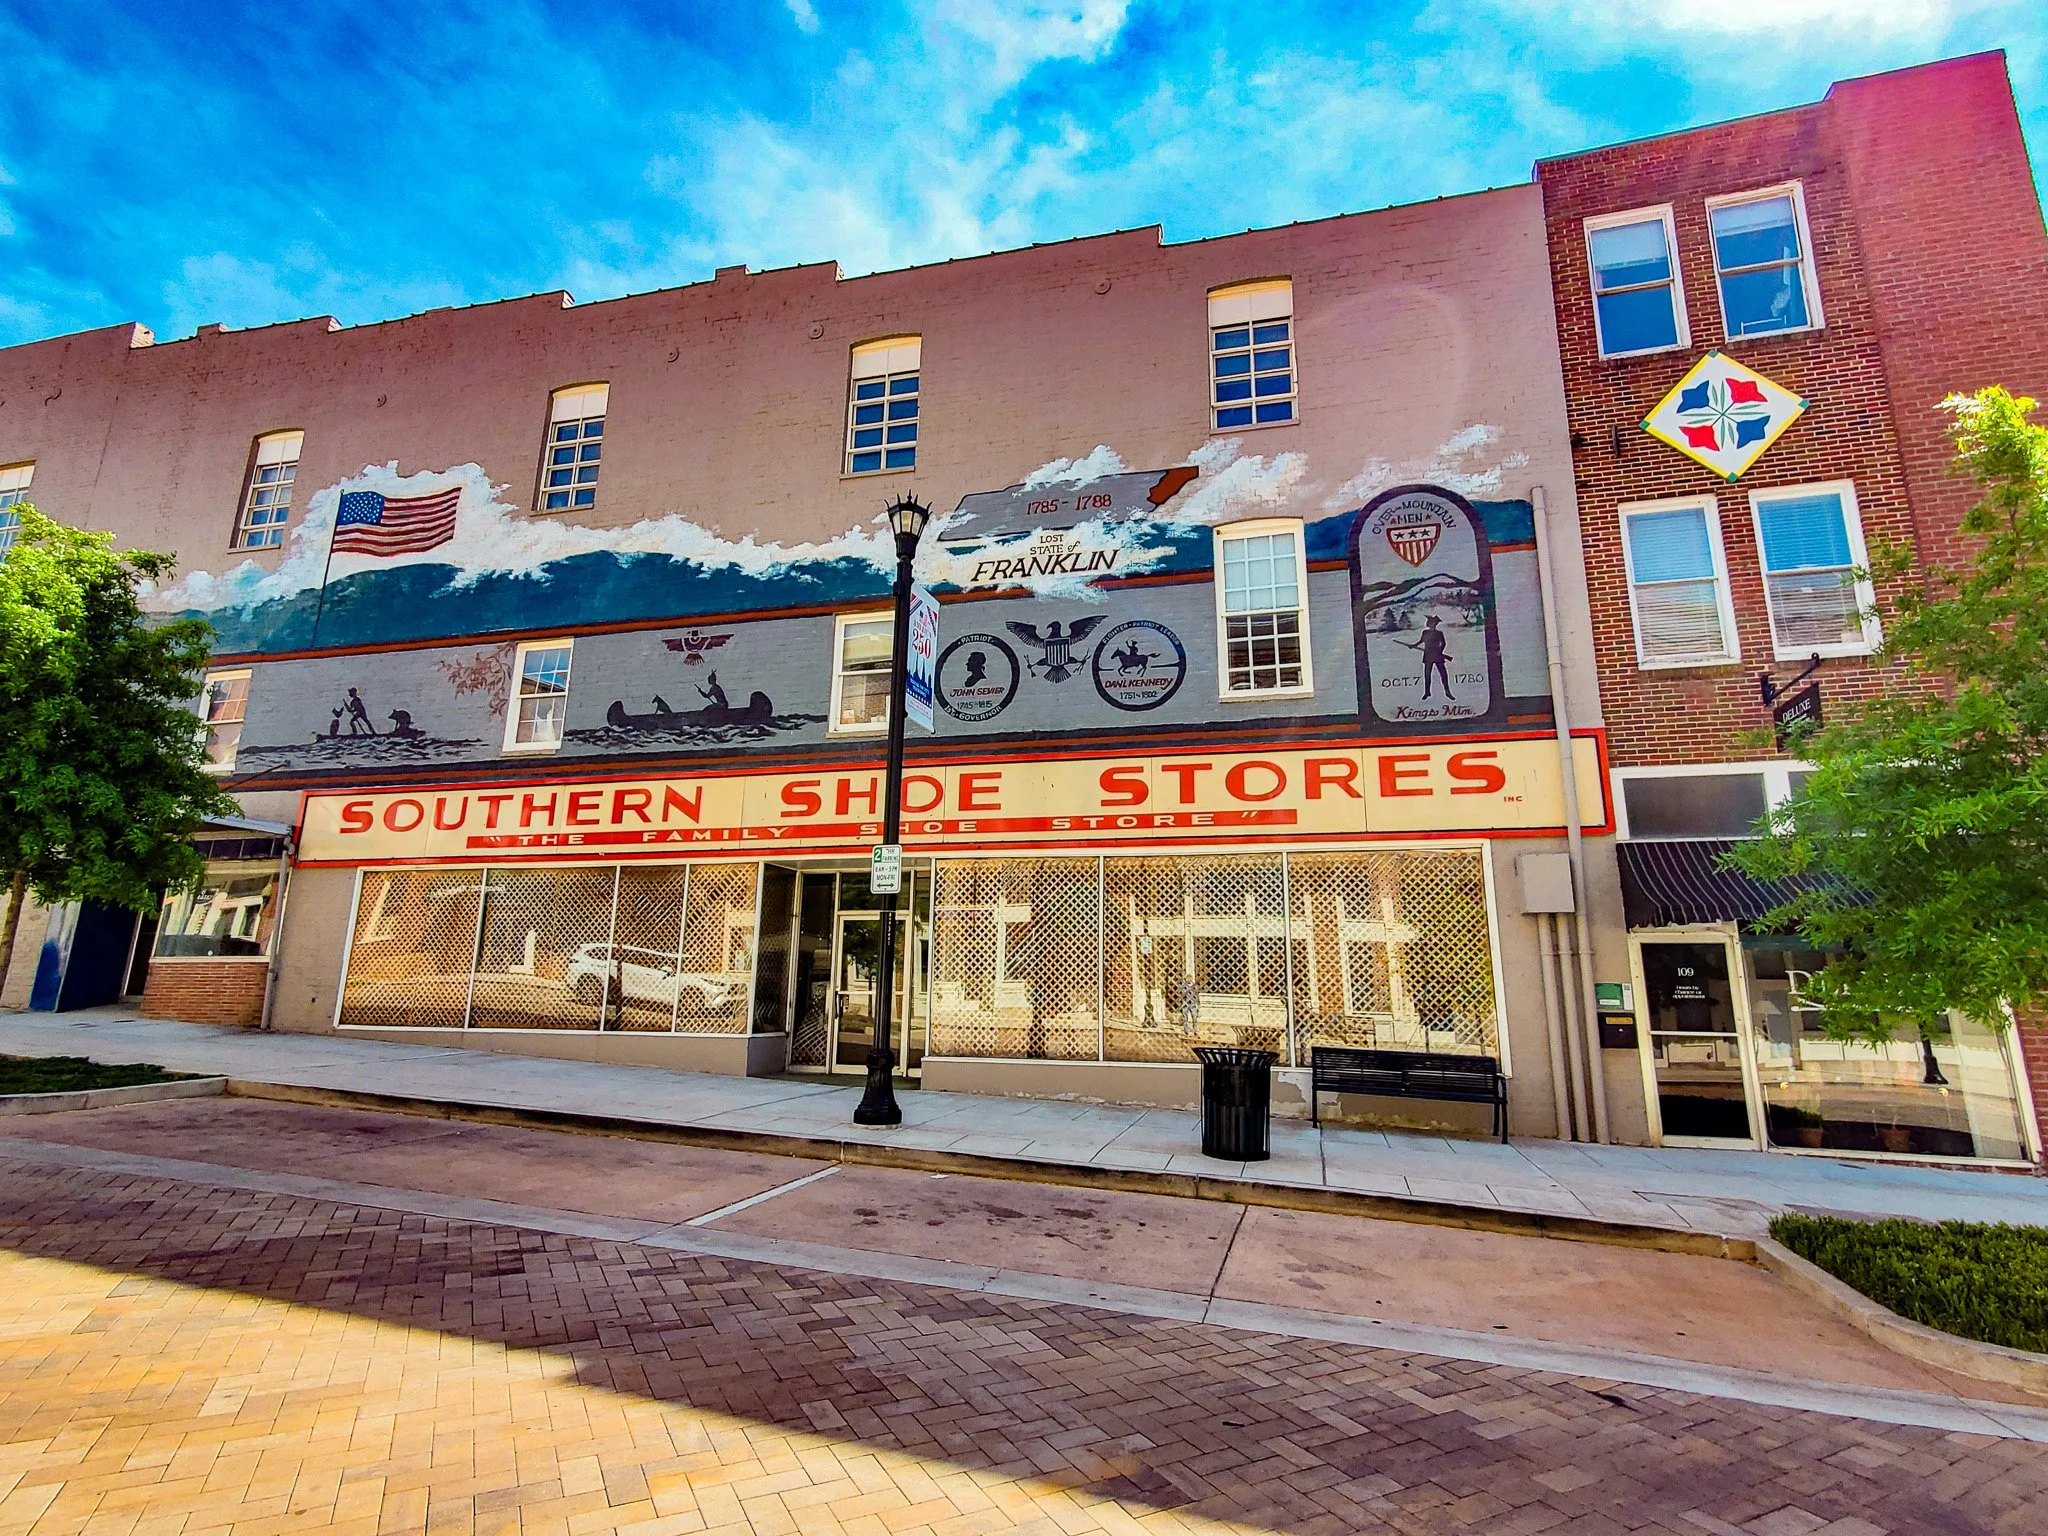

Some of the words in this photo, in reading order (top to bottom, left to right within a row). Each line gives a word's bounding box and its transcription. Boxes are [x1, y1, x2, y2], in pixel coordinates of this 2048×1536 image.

[1026, 499, 1060, 516] 1785
[1075, 493, 1113, 511] 1788
[1397, 513, 1424, 525] MEN
[1040, 534, 1064, 544] LOST
[1029, 544, 1064, 556] STATE
[1067, 540, 1081, 553] of
[970, 549, 1122, 583] FRANKLIN
[911, 628, 932, 660] 250
[960, 634, 993, 643] PATRIOT
[1128, 677, 1174, 690] KENNEDY
[1454, 673, 1485, 684] 1780
[949, 688, 976, 698] JOHN
[976, 686, 1005, 696] SEVIER
[1782, 699, 1811, 722] DELUXE
[339, 783, 704, 834] SOUTHERN
[779, 771, 1003, 818] SHOE
[1099, 750, 1507, 807] STORES
[641, 826, 790, 843] FAMILY
[874, 849, 881, 860] 2
[1678, 967, 1694, 976] 109
